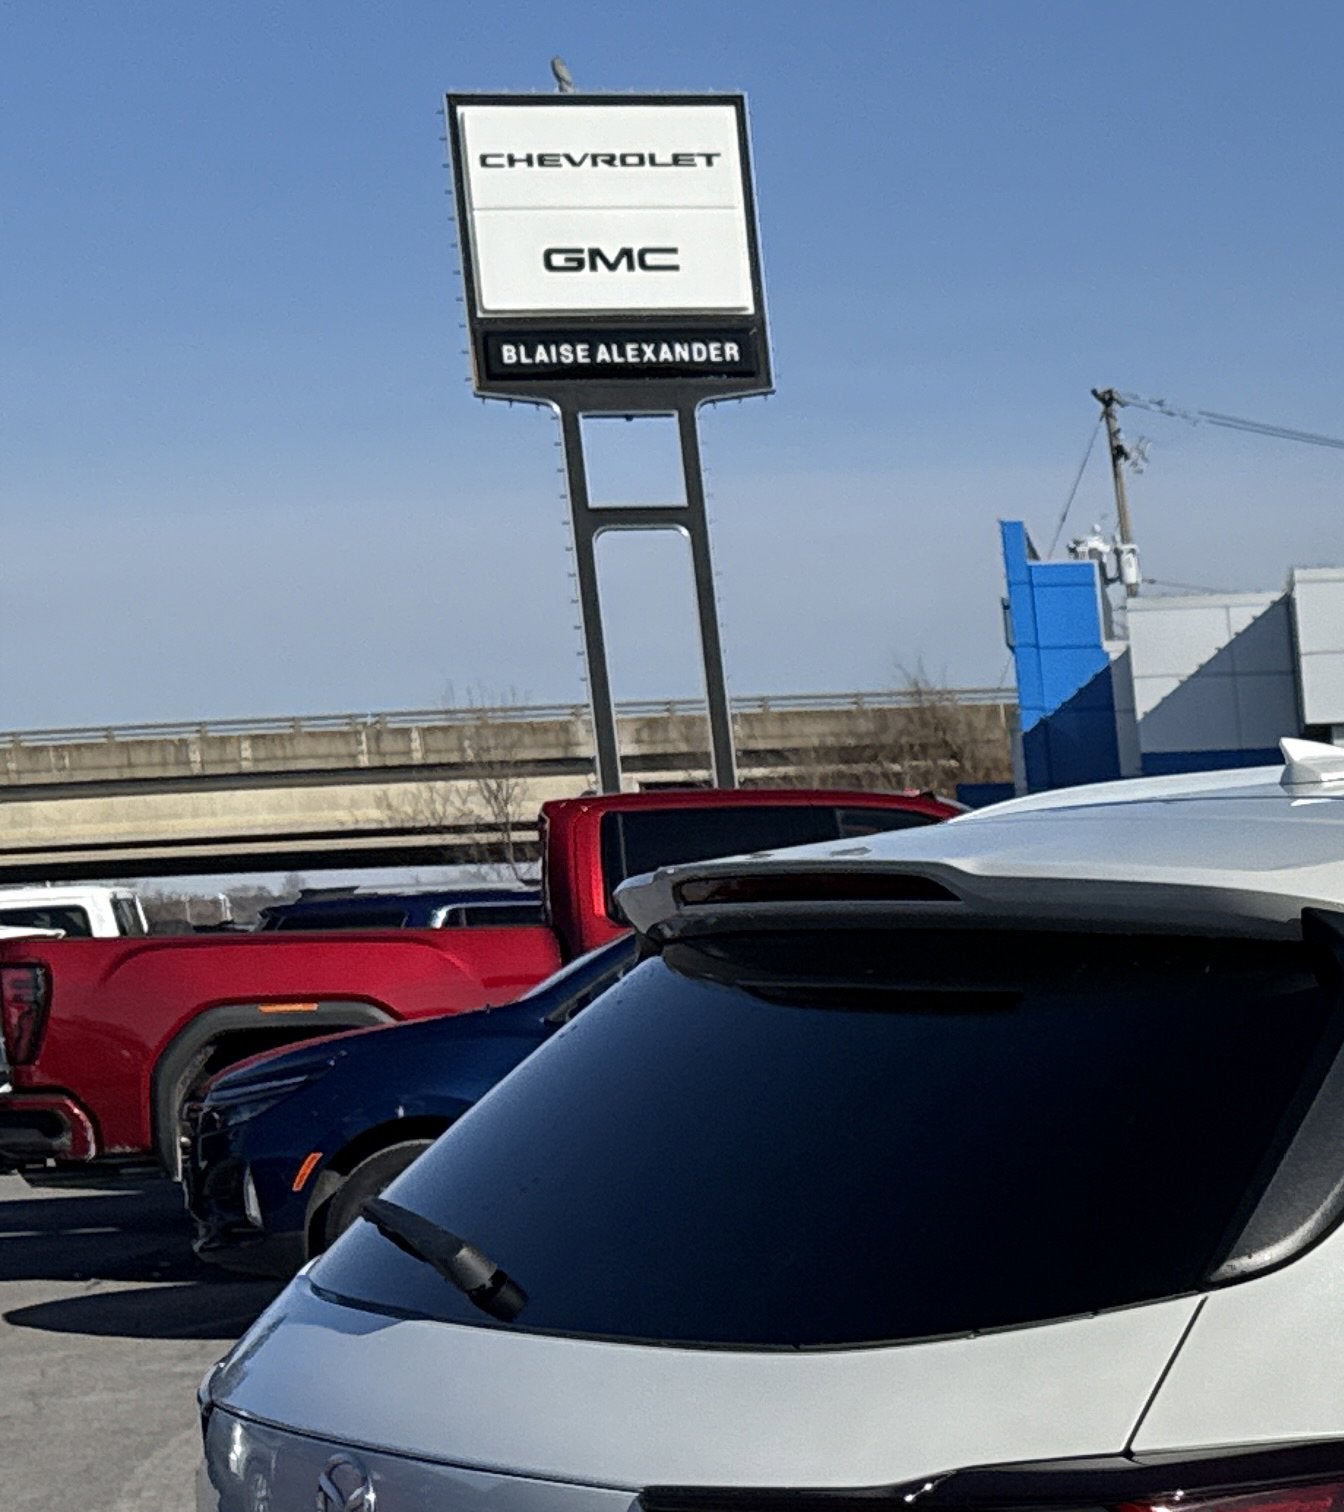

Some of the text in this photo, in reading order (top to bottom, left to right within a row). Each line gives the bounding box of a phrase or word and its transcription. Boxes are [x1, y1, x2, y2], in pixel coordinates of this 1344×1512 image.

[479, 152, 721, 169] CHEVROLET
[543, 247, 680, 273] GMC
[502, 342, 740, 364] BLAISE ALEXANDER
